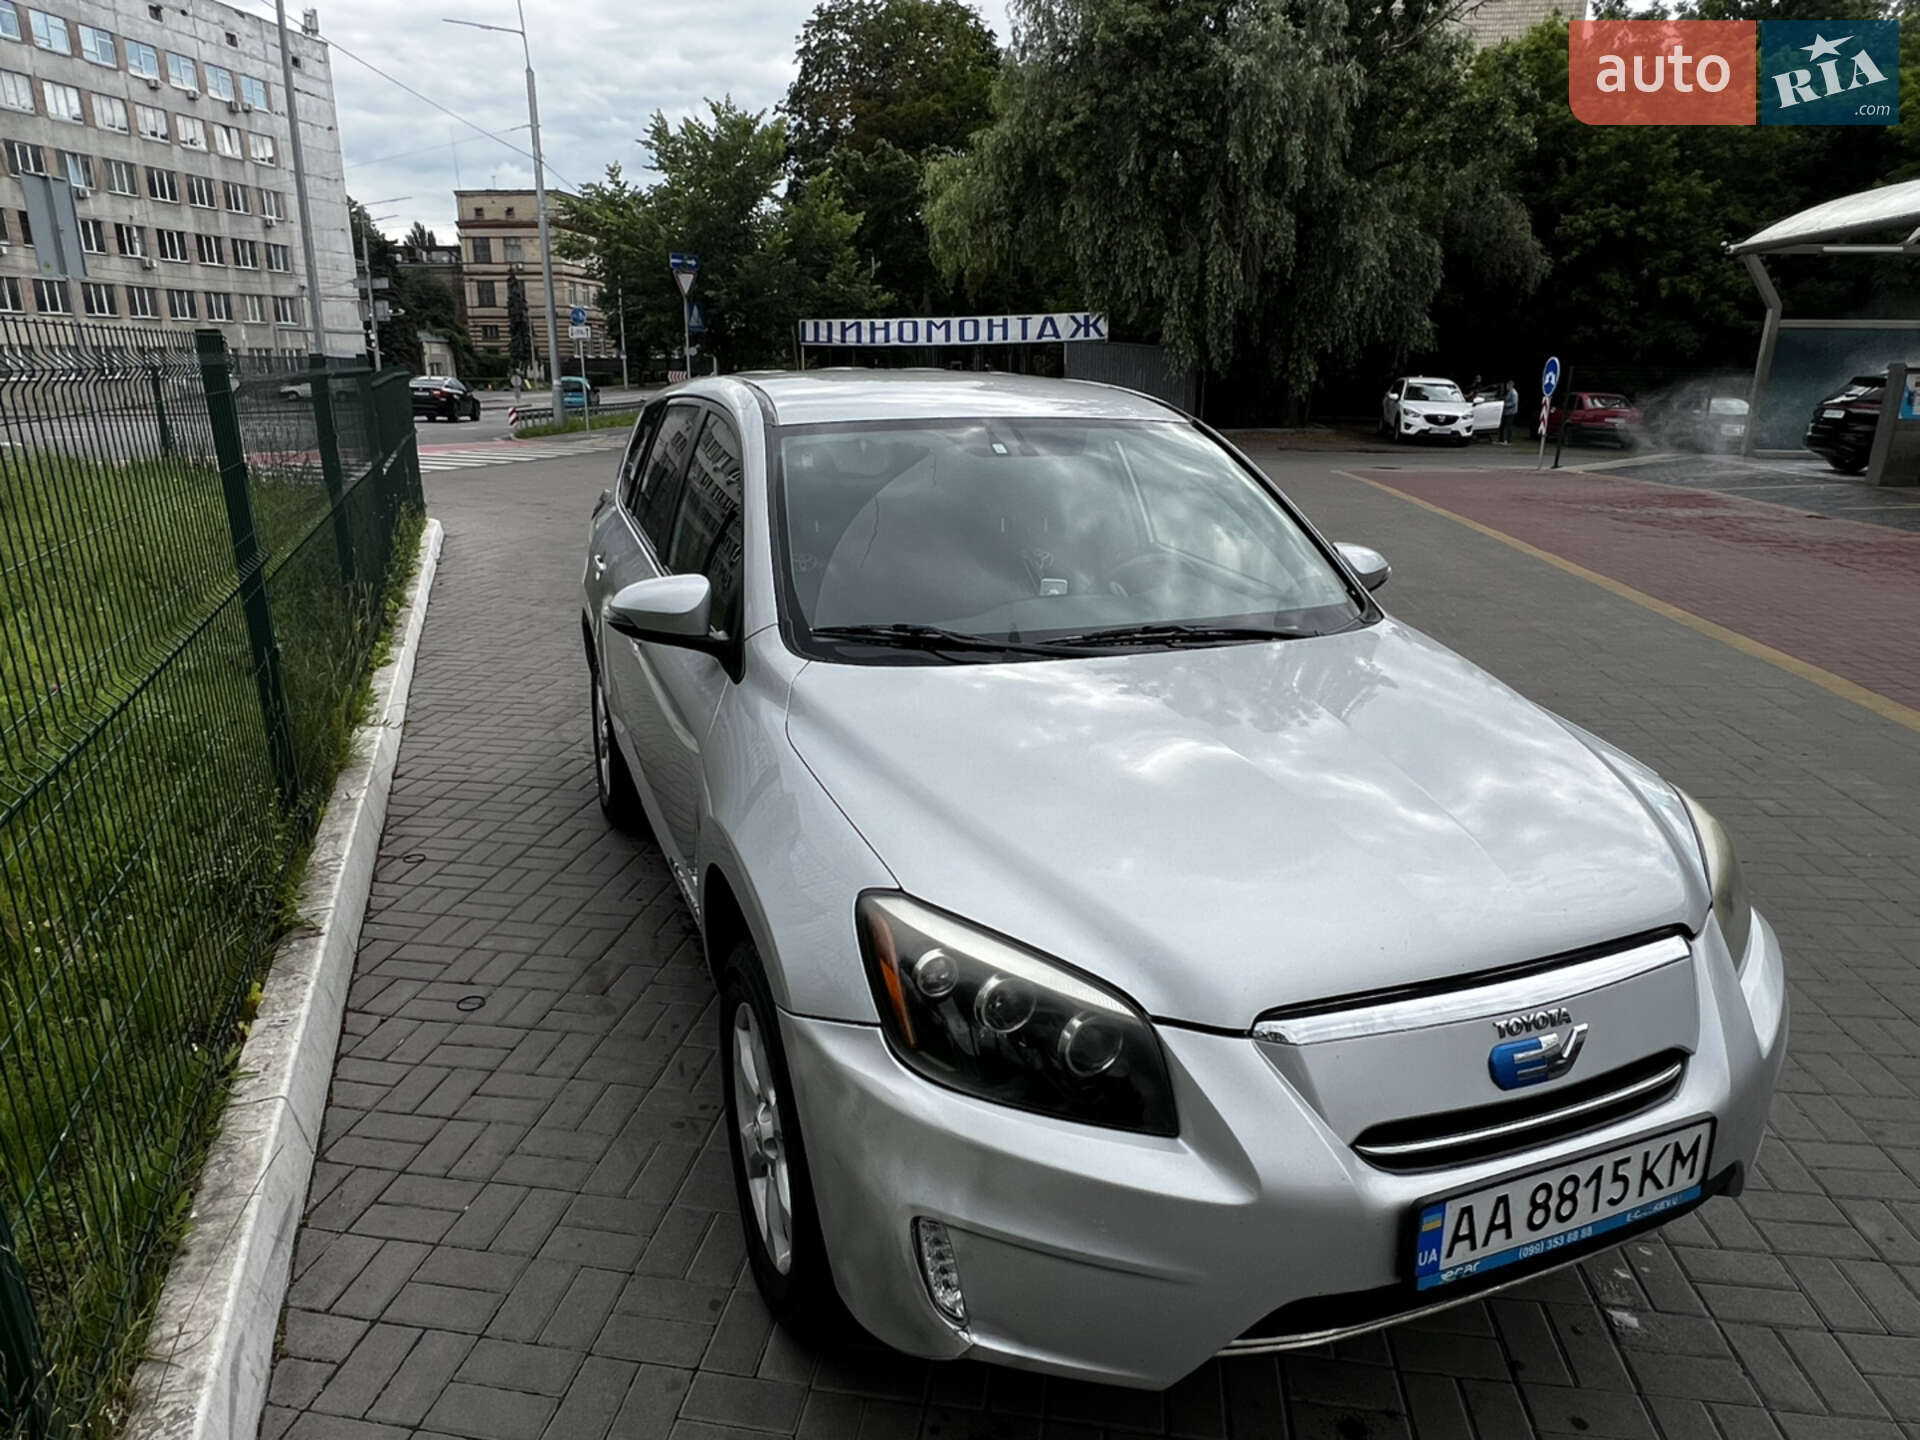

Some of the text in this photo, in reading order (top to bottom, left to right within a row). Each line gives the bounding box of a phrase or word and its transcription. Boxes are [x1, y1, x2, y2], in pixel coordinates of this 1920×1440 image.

[801, 314, 1106, 344] ШИНОМОНТАЖ
[1493, 1007, 1572, 1039] TOYOTA
[1445, 1134, 1702, 1259] AA 8815 KM
[1418, 1248, 1438, 1266] UA
